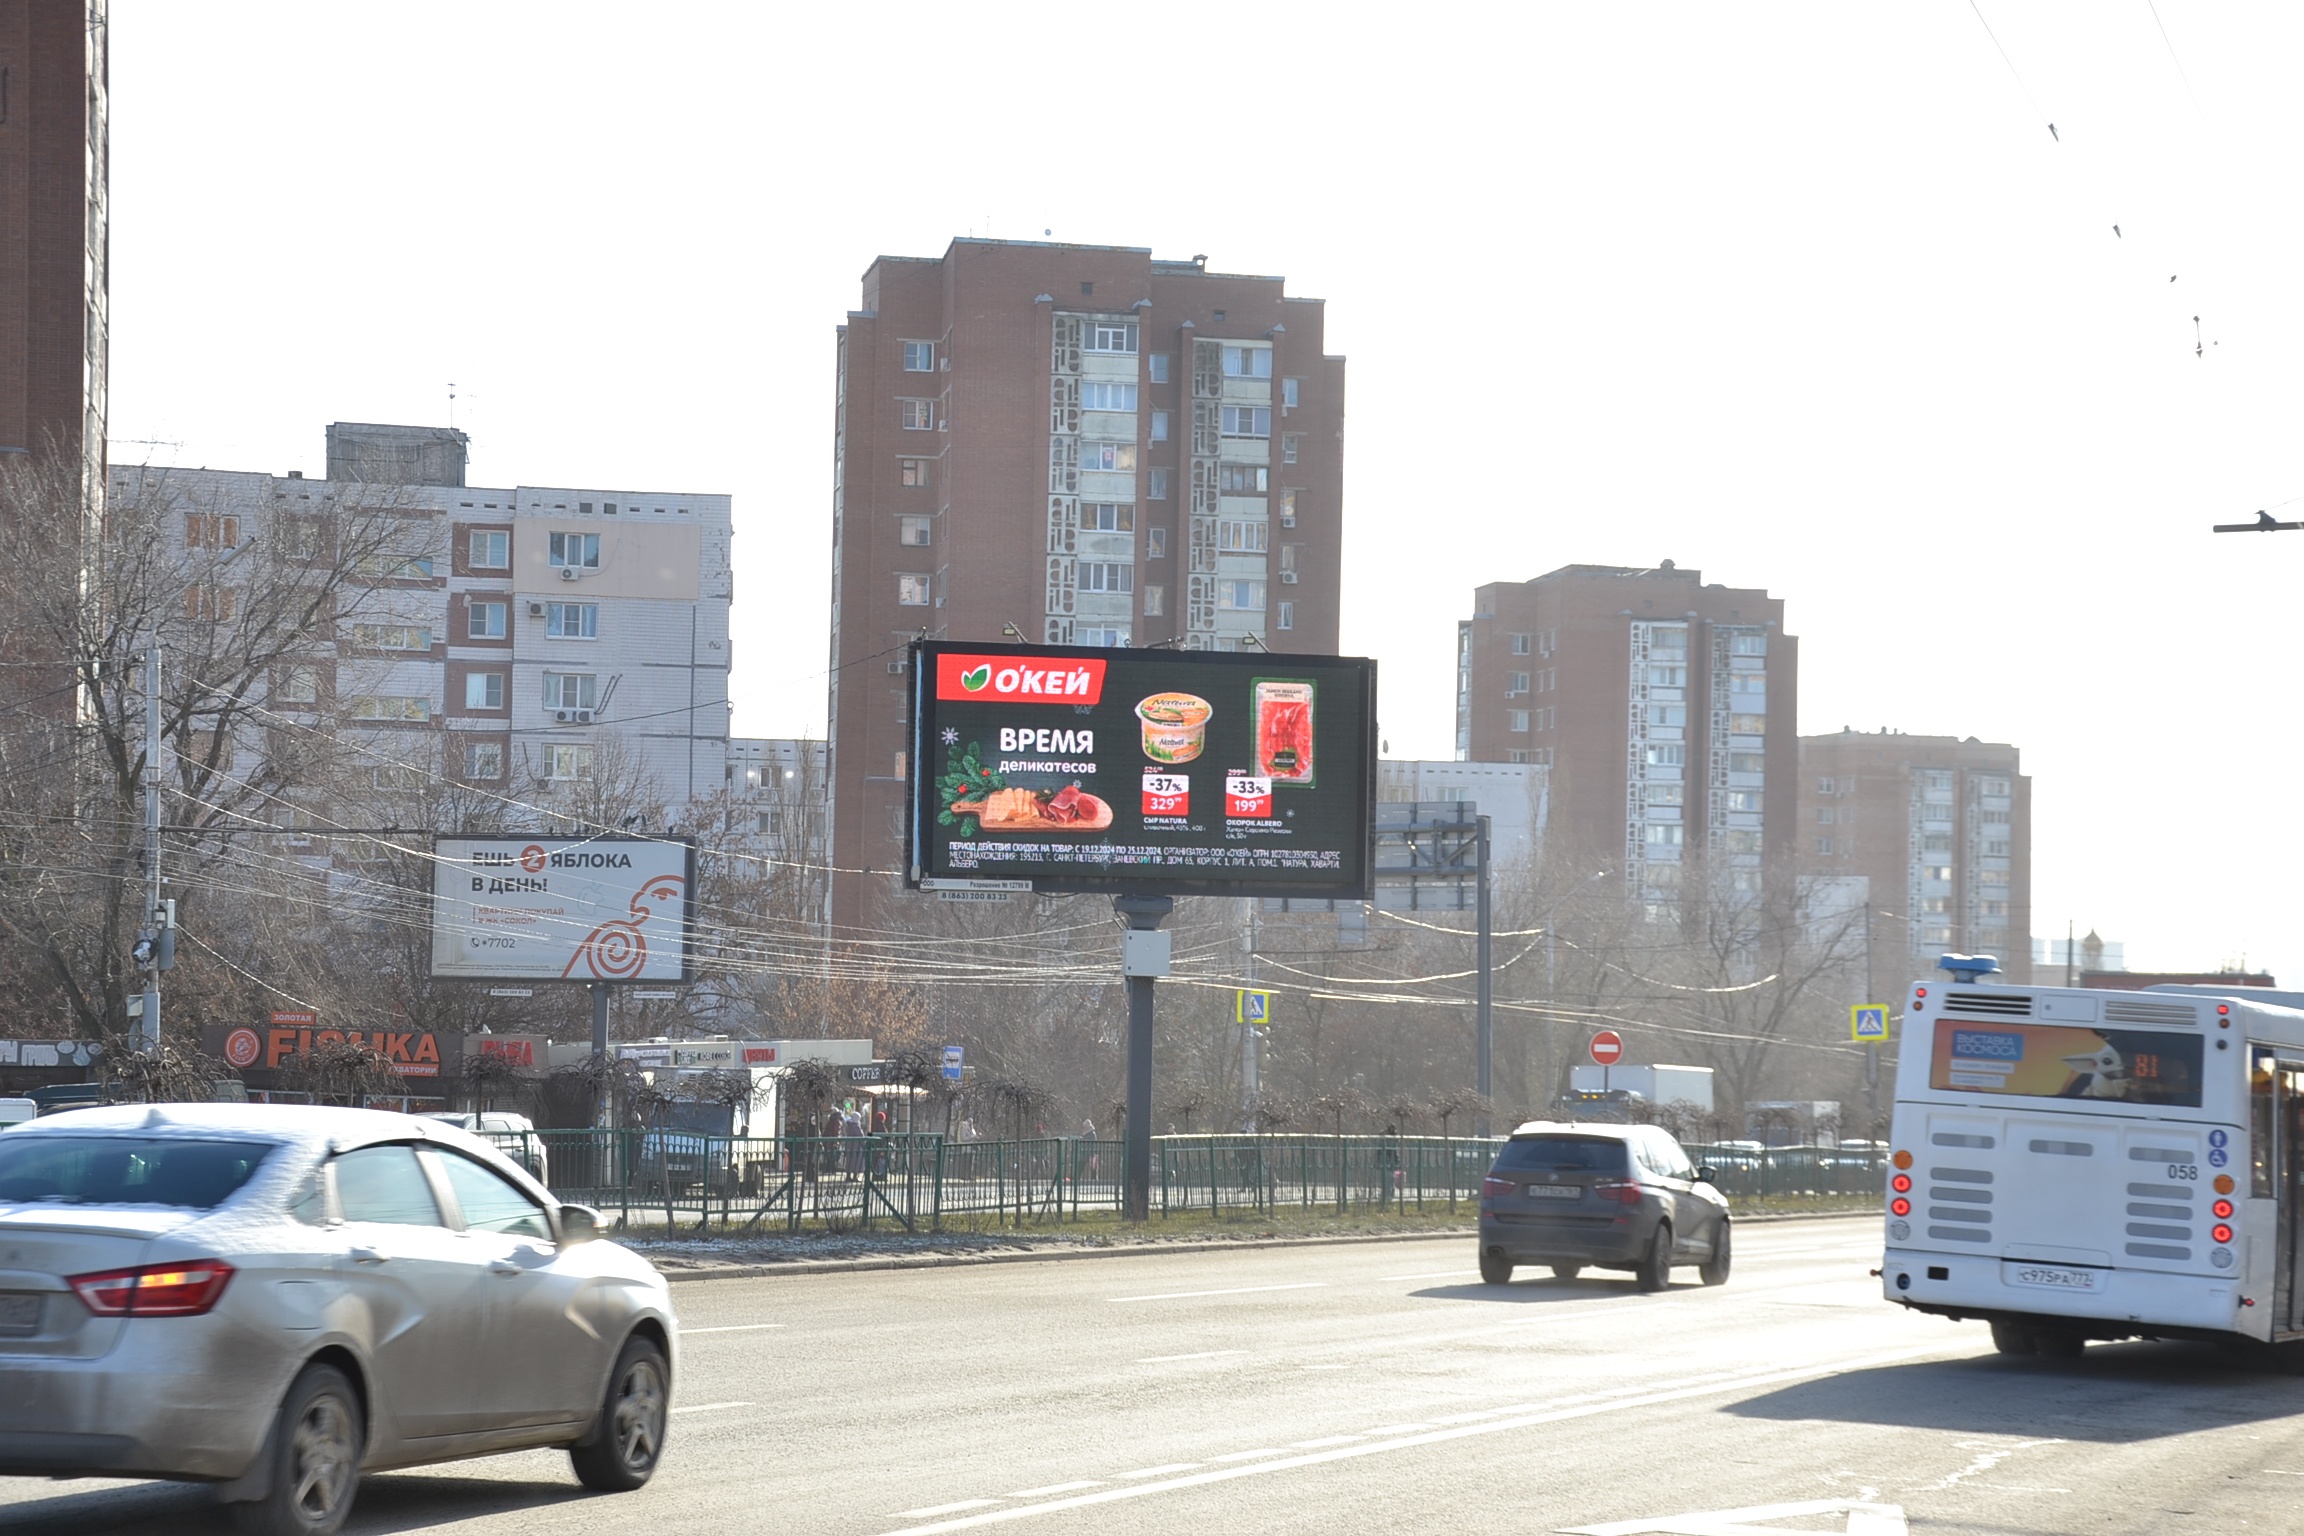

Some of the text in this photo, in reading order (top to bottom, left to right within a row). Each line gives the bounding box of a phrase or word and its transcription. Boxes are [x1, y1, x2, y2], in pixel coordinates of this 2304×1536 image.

[1000, 727, 1094, 754] ВРЕМЯ
[999, 760, 1097, 774] деликатесов
[1149, 778, 1182, 792] -37%
[1233, 781, 1265, 794] -33%
[1160, 817, 1187, 825] NATURA
[1226, 819, 1255, 827] ОКОРОК
[949, 841, 976, 851] ПЕРИОД
[977, 841, 1012, 851] ДЕЙСТВИЯ
[1012, 843, 1039, 852] СКИДОК
[1040, 843, 1050, 853] НА
[1081, 845, 1115, 854] 19.12.2024
[1116, 845, 1126, 854] ПО
[1320, 850, 1341, 860] АДРЕС
[472, 852, 515, 867] ЕШЬ
[550, 853, 632, 868] ЯБЛОКА
[1166, 856, 1183, 865] ДОМ
[471, 877, 548, 895] В ДЕНЬ!
[969, 881, 1001, 889] Разрешение
[948, 892, 969, 900] (863)
[970, 892, 985, 900] 200
[998, 893, 1008, 901] 23
[525, 907, 565, 916] ПОКУПАЙ
[273, 1014, 312, 1023] ЗОЛОТАЯ
[1956, 1033, 2014, 1046] ВЫСТАВКА
[1956, 1043, 2017, 1057] КОСМОСА
[2168, 1164, 2198, 1180] 058
